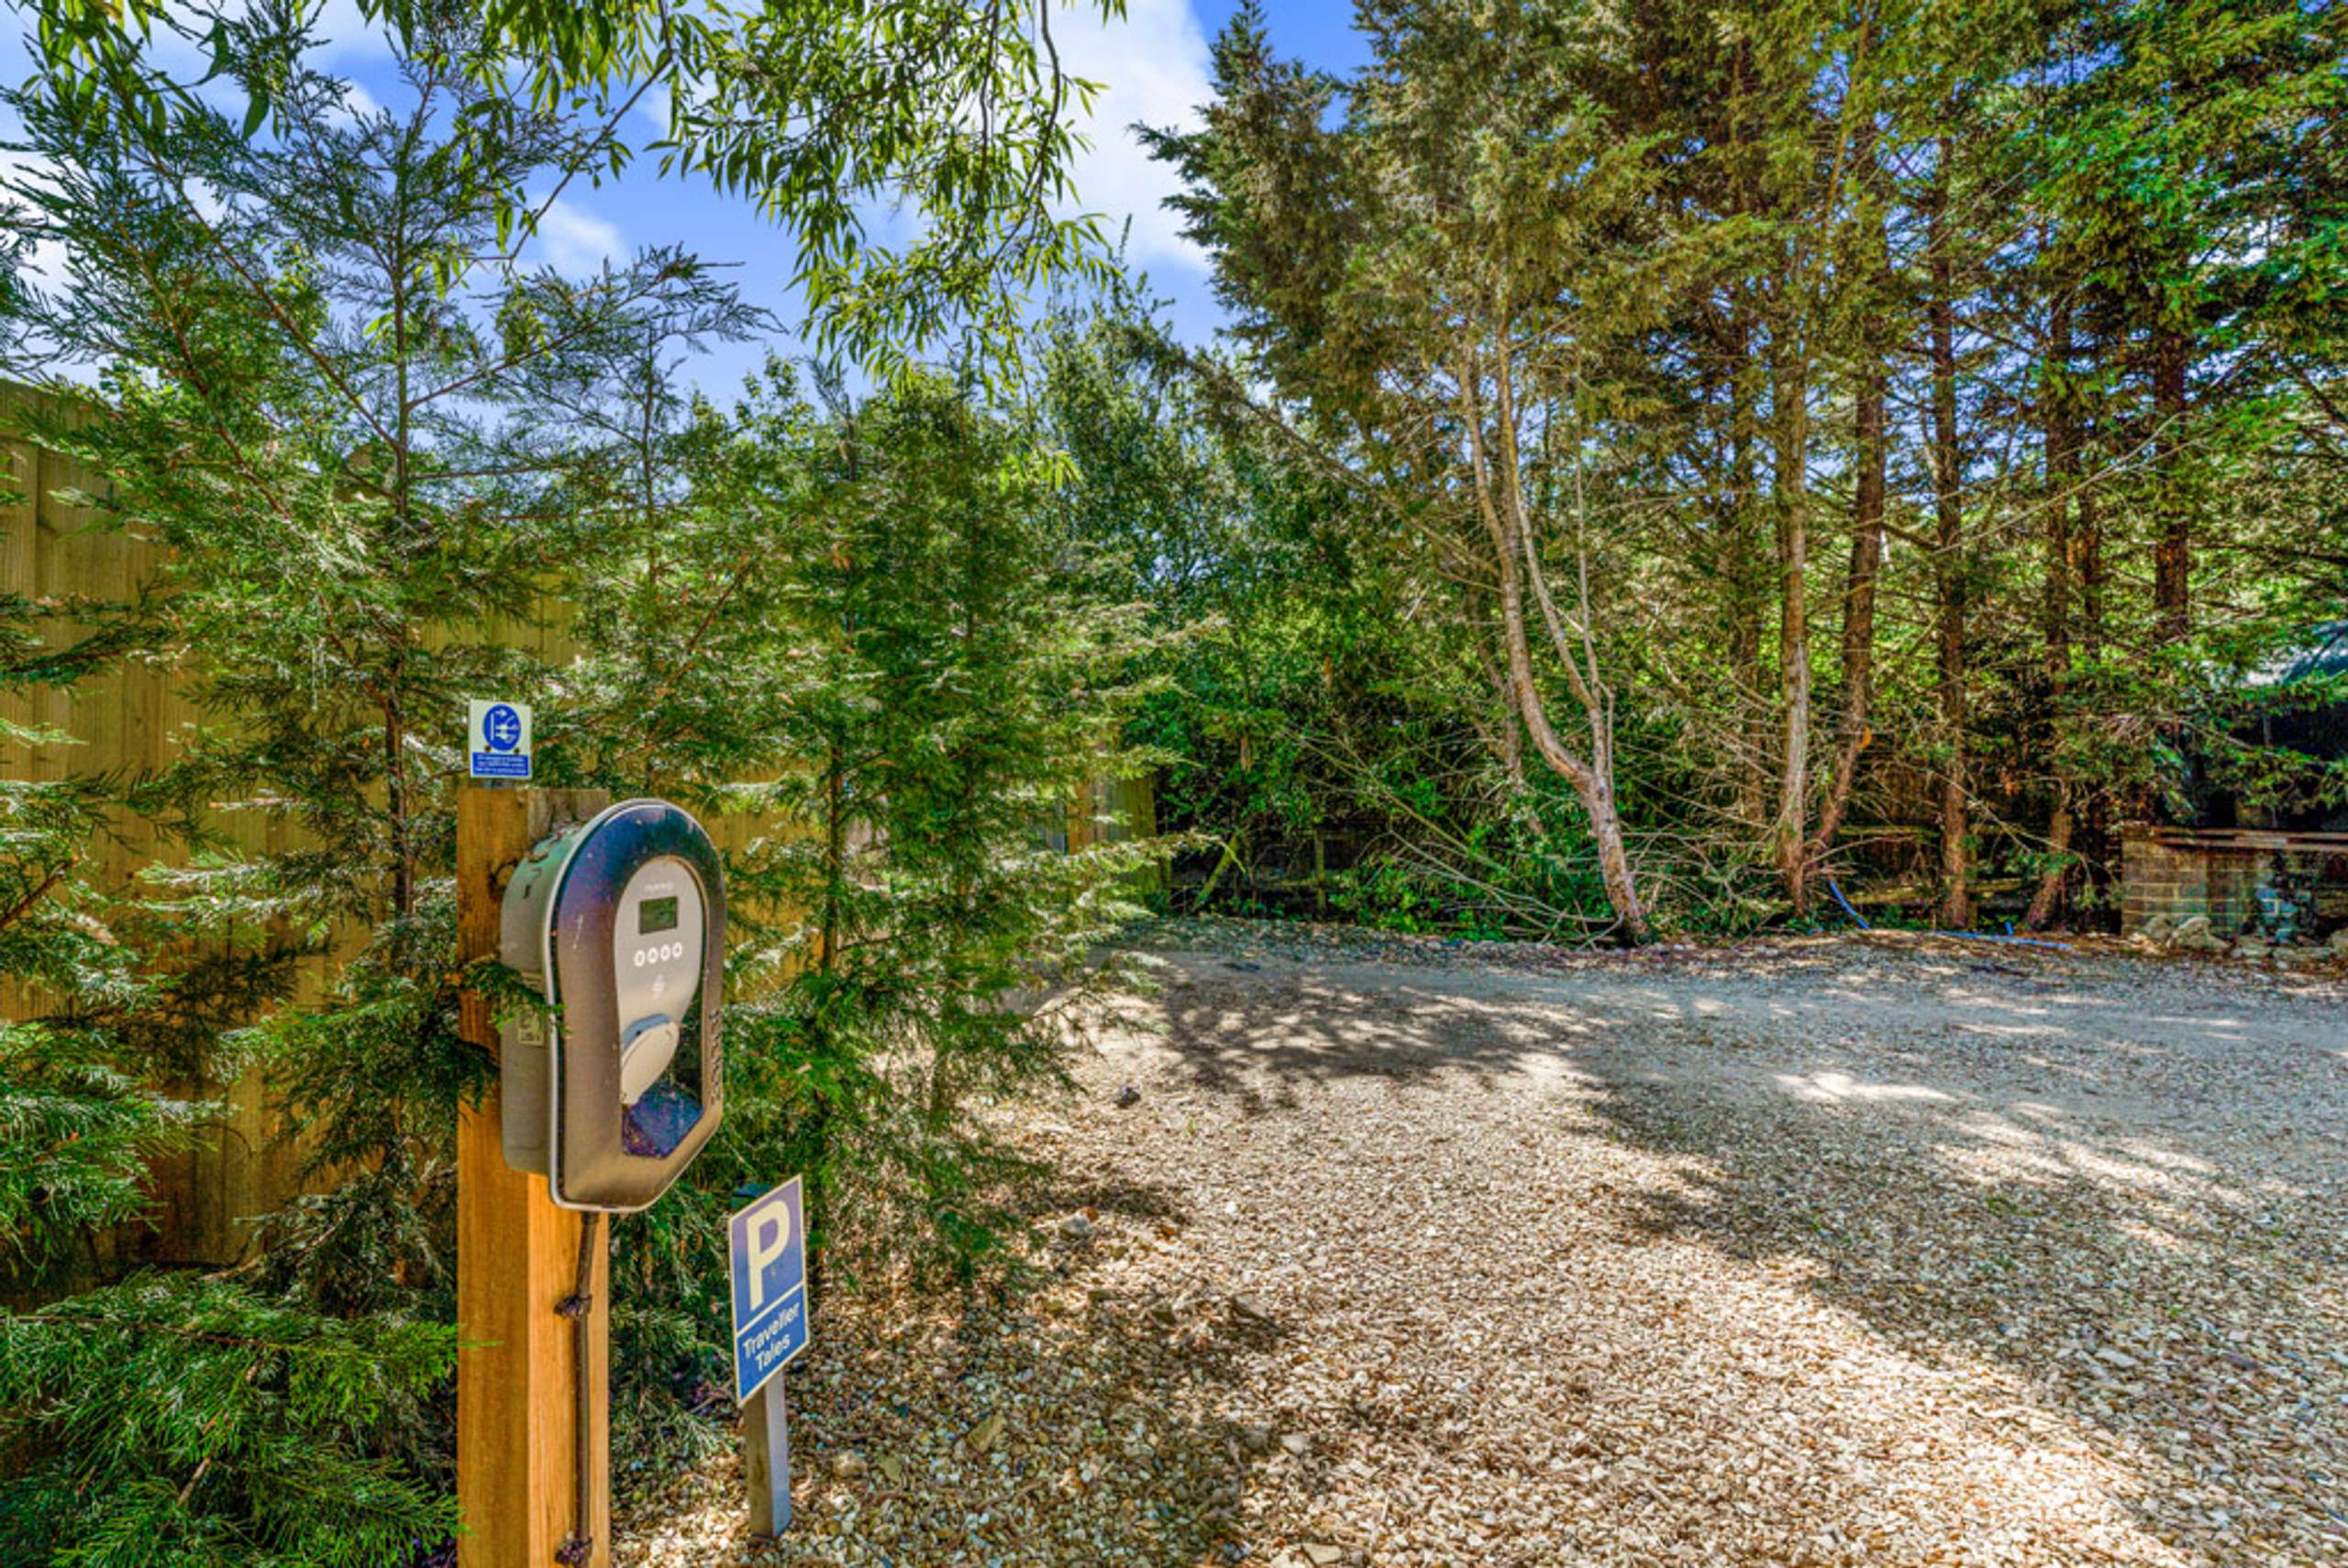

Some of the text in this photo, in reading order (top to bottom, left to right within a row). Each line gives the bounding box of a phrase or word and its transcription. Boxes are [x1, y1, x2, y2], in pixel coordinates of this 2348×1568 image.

[747, 1199, 791, 1311] P
[743, 1301, 800, 1359] Traveller
[755, 1334, 792, 1374] Tales
